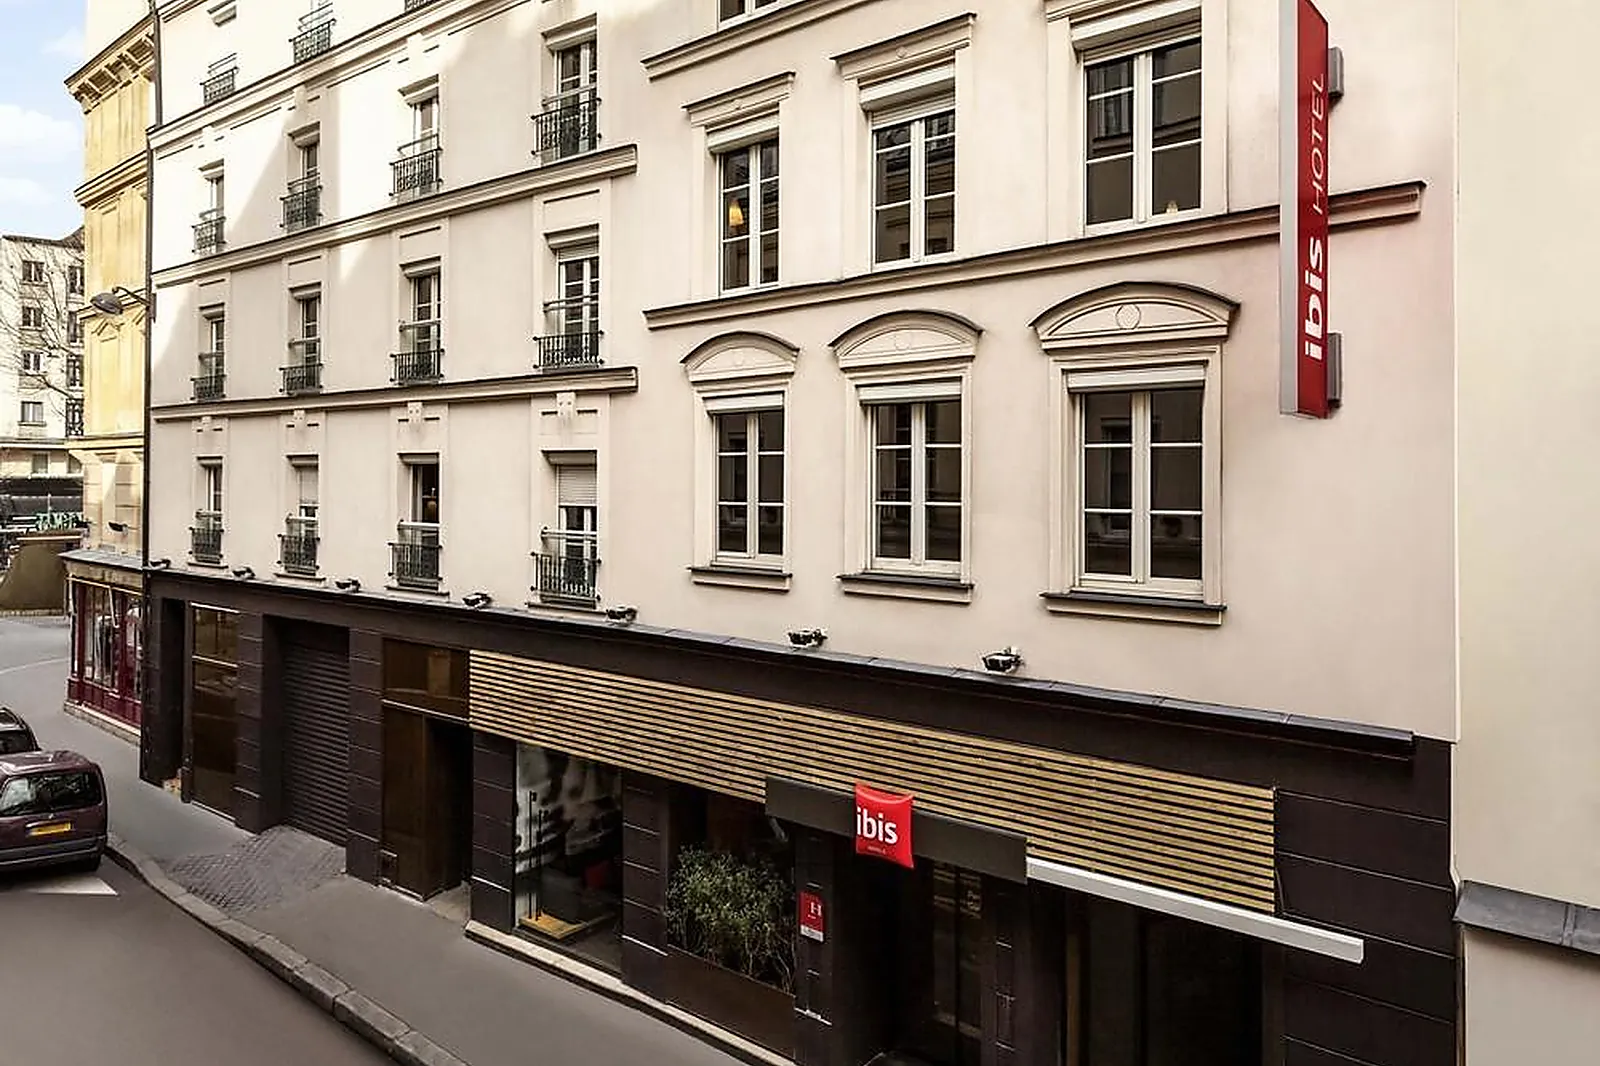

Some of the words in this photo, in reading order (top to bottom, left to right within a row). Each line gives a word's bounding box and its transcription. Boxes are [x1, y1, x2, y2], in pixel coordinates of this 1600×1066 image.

[1311, 73, 1324, 215] HOTEL
[1305, 236, 1322, 360] ibis
[856, 805, 898, 844] ibis
